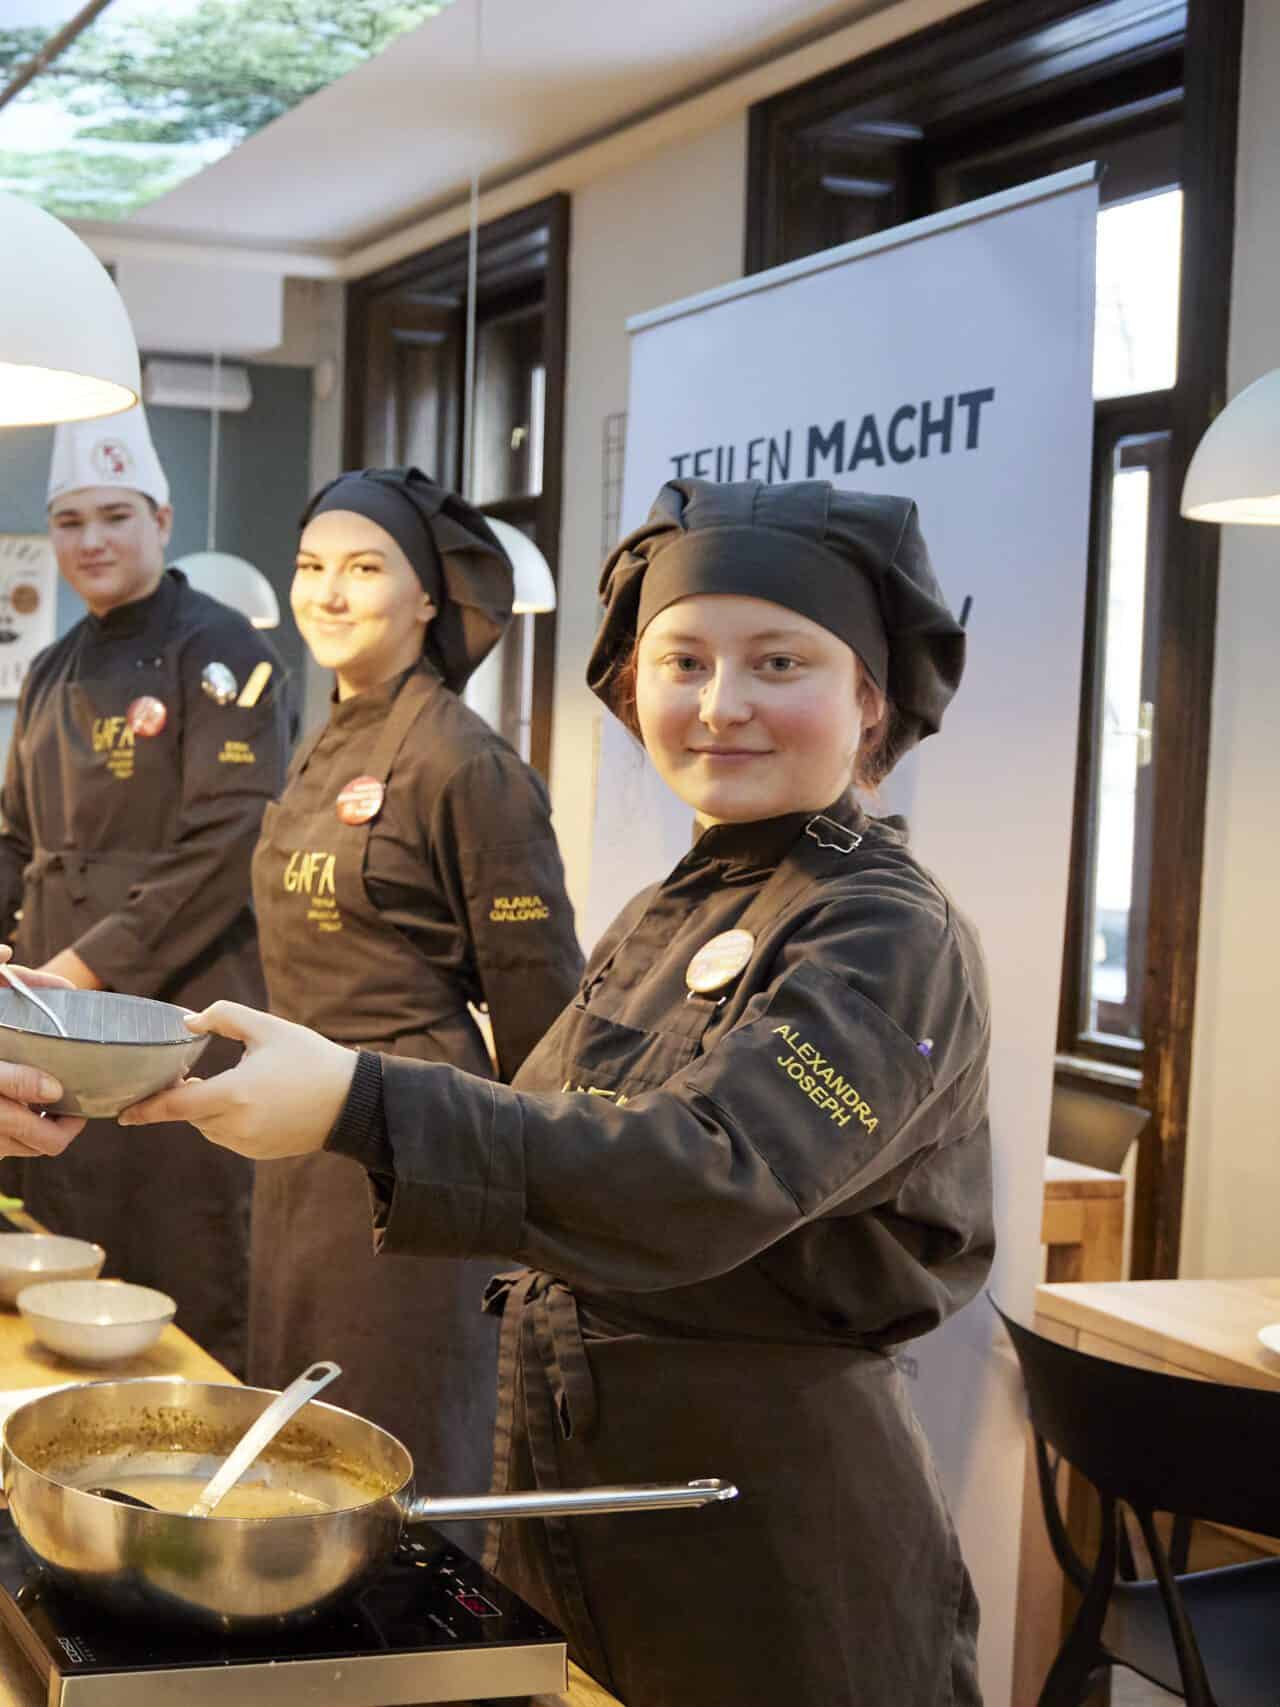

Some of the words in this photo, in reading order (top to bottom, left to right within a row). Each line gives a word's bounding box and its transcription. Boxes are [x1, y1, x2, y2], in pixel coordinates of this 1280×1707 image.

[806, 387, 996, 479] MACHT
[771, 1024, 879, 1135] ALEXANDRA
[777, 1055, 851, 1127] JOSEPH
